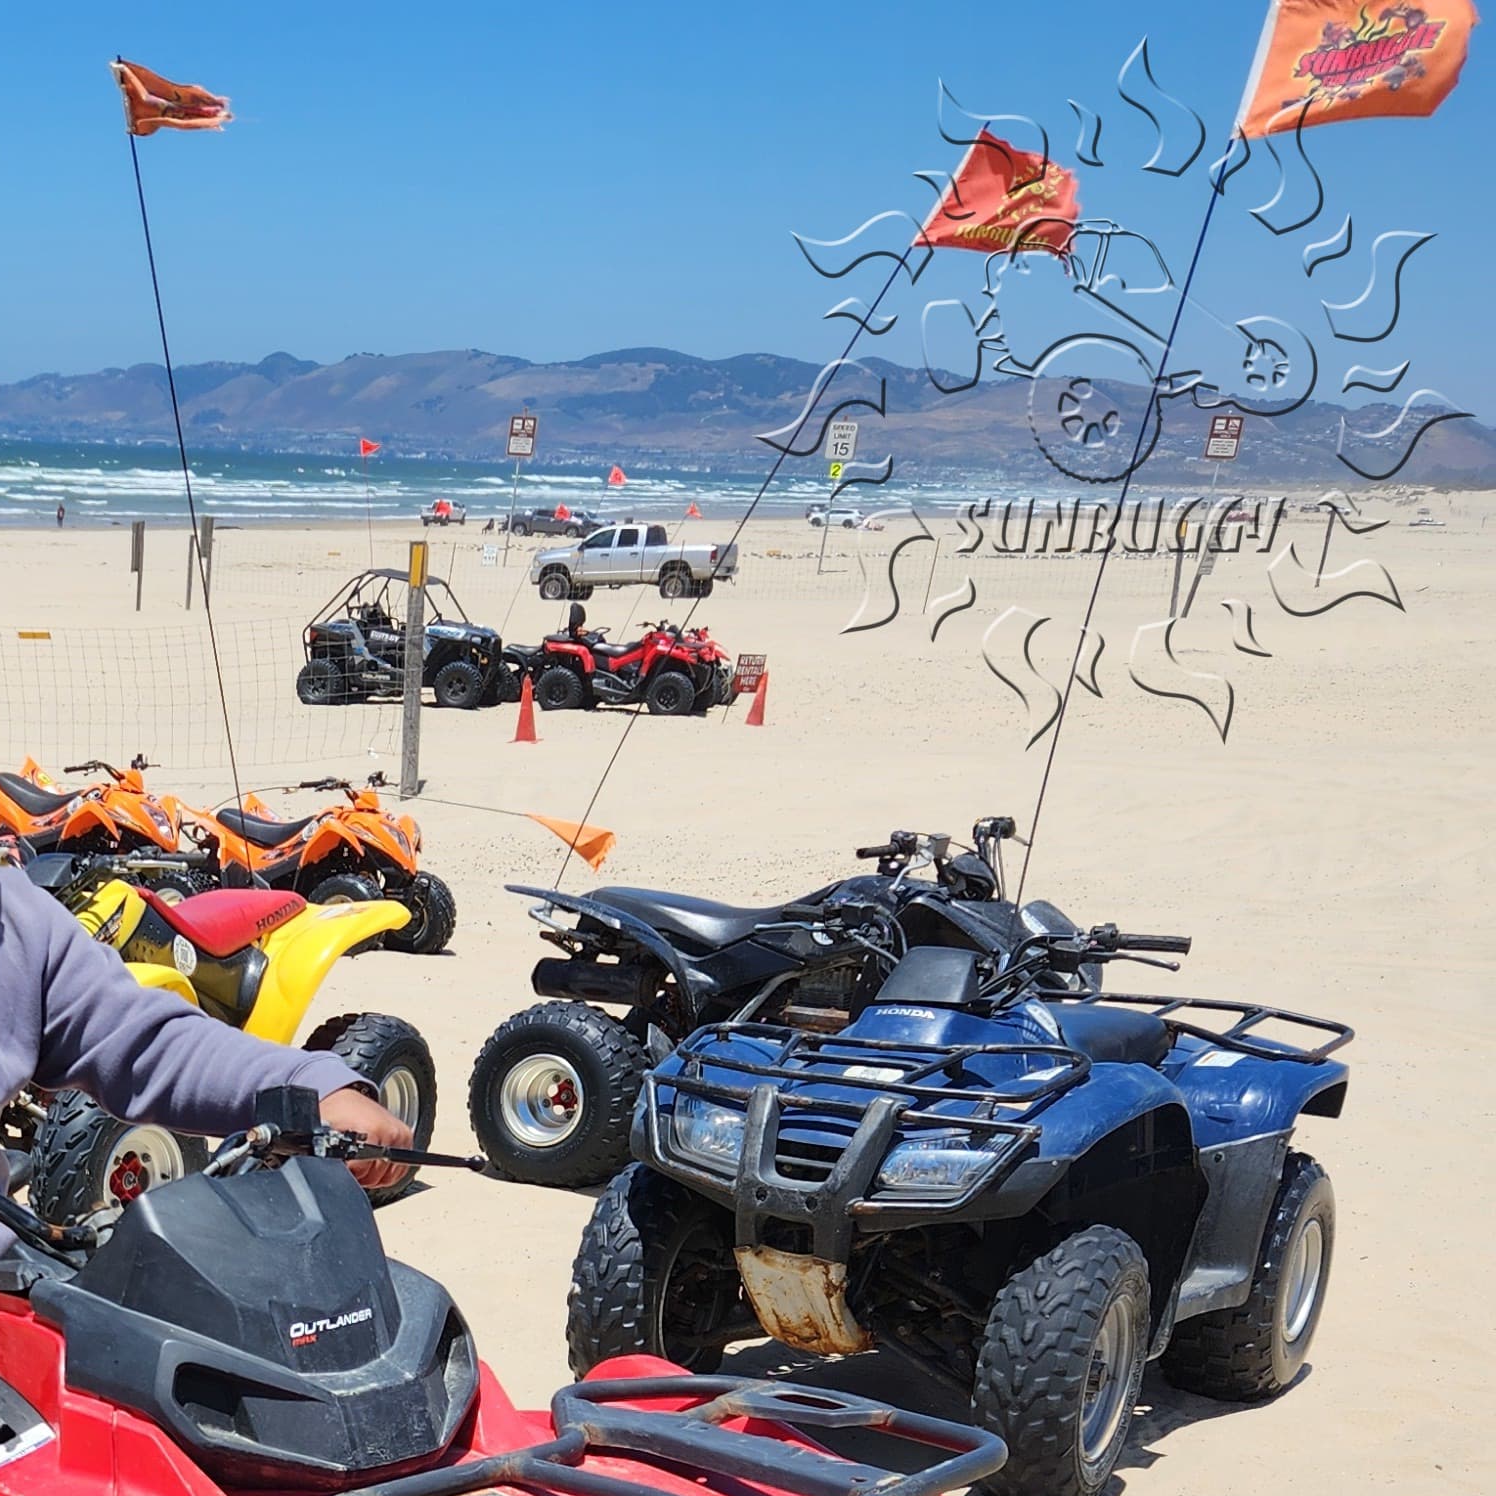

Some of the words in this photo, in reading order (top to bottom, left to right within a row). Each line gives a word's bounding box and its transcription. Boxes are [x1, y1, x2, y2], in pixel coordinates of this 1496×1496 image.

[832, 442, 850, 456] 15
[831, 464, 841, 477] 2
[256, 899, 301, 931] HONDA
[874, 1007, 936, 1021] HONDA
[289, 1307, 373, 1339] OUTLANDER
